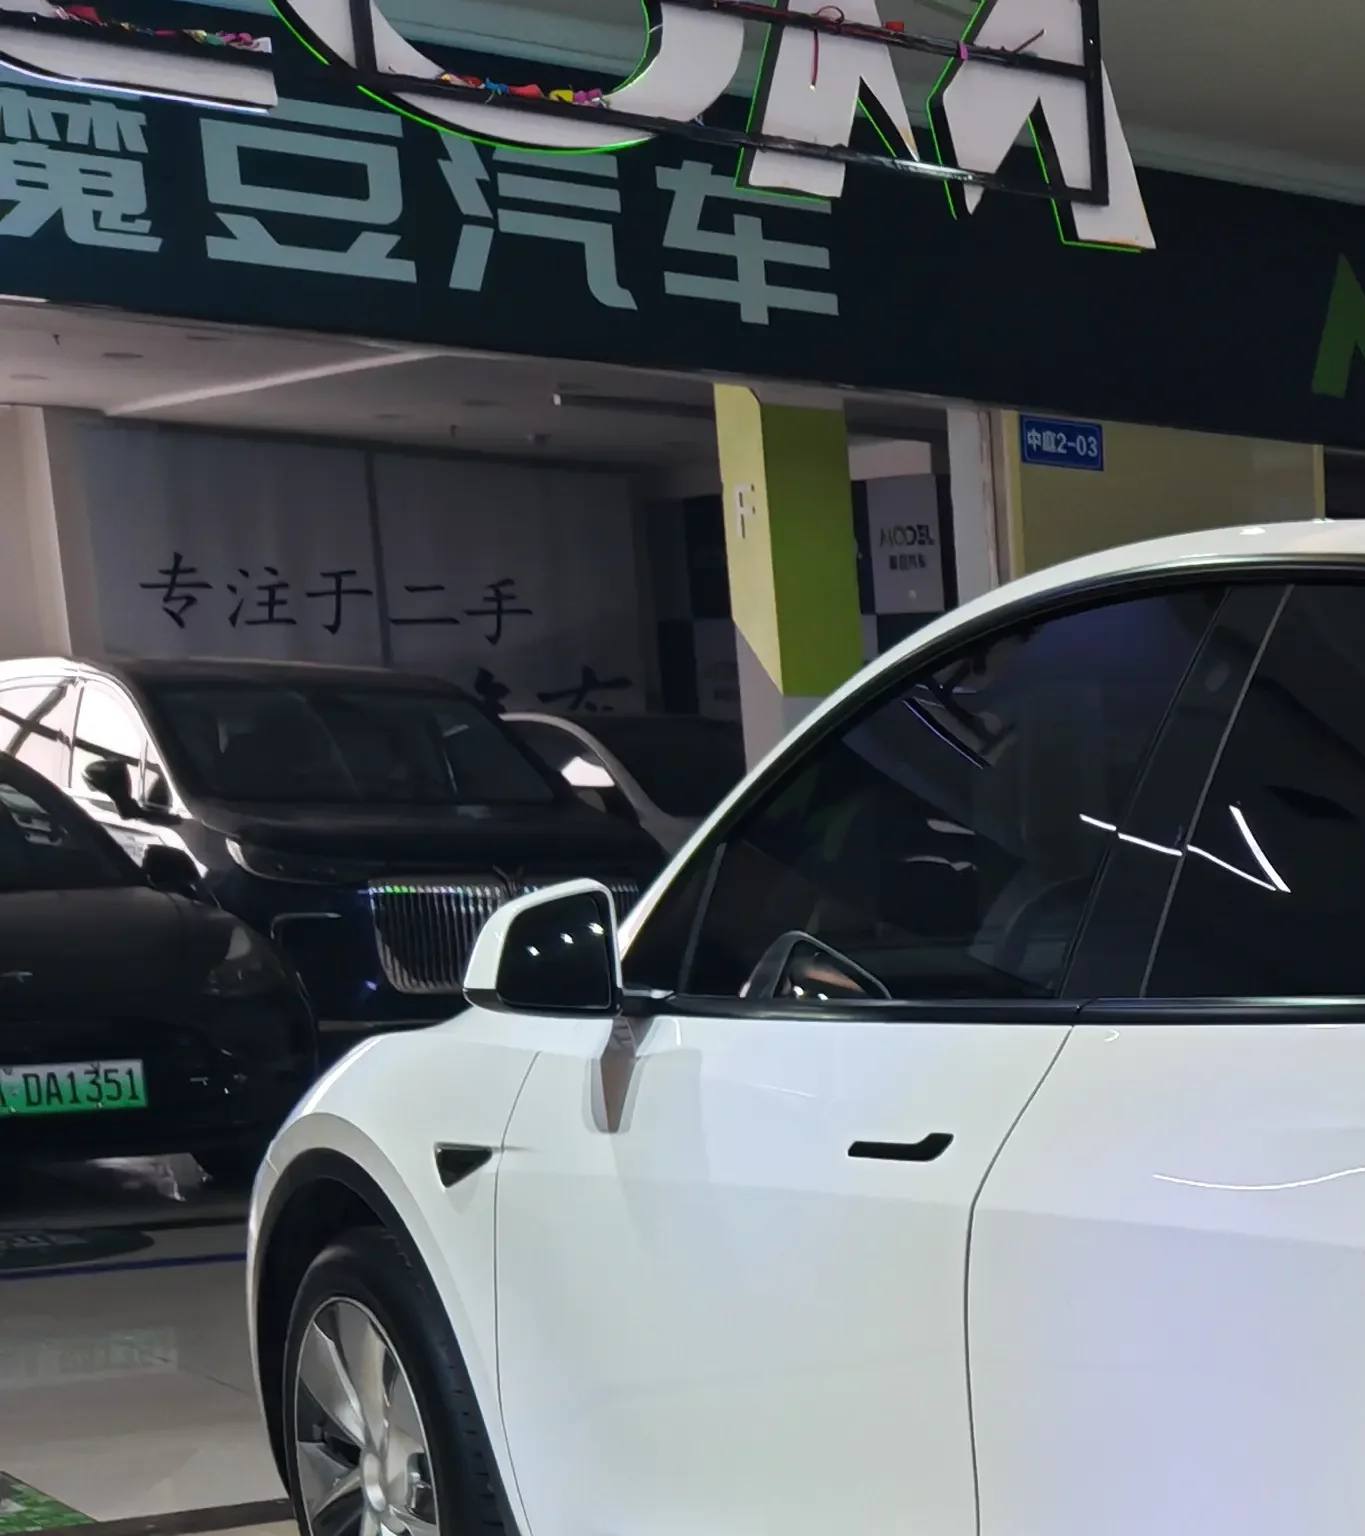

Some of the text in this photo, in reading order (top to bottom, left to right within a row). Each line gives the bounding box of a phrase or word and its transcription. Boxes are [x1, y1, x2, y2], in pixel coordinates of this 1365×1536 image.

[1027, 428, 1099, 458] 中庭2-03
[139, 551, 534, 645] 专注于二手
